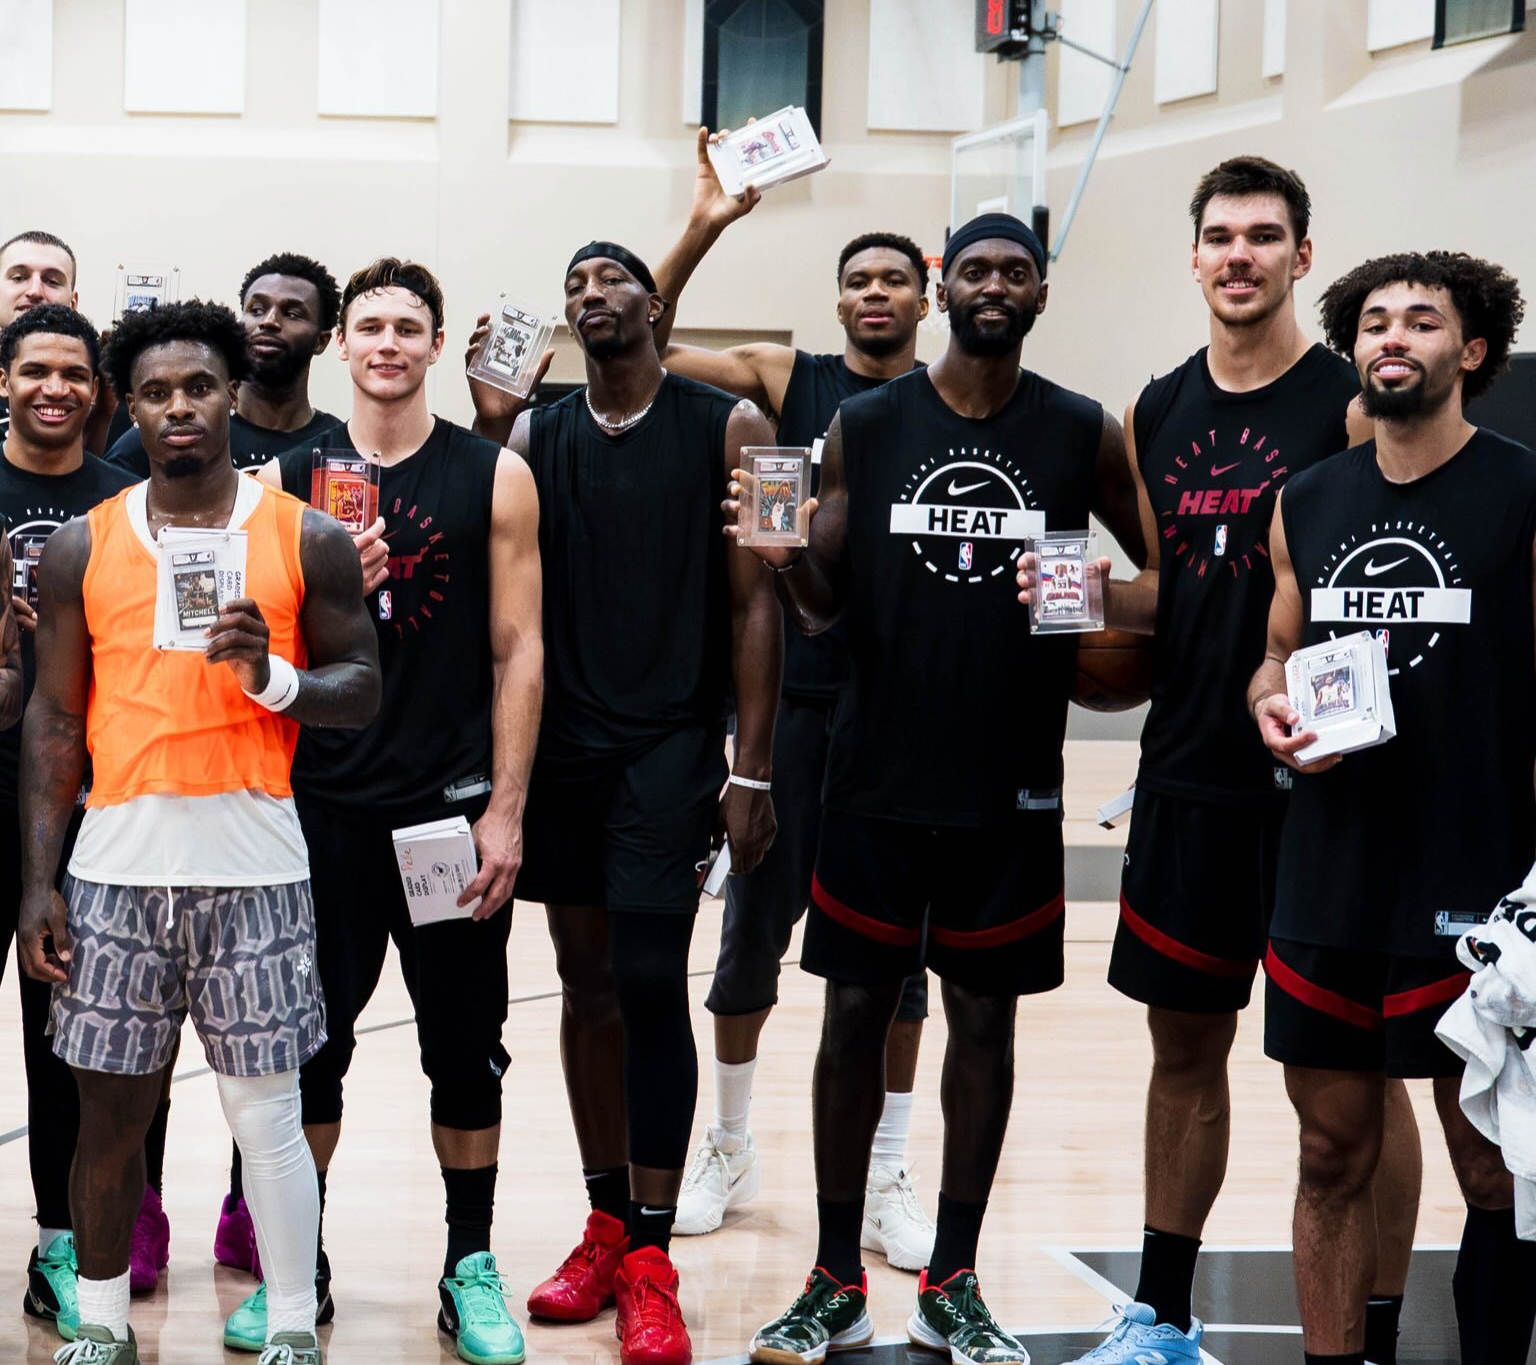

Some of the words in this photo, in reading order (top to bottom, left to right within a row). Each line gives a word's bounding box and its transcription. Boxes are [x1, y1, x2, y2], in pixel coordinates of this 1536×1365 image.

[1177, 480, 1270, 516] HEAT
[928, 507, 1008, 536] HEAT
[182, 606, 216, 618] MITCHELL
[1343, 590, 1425, 620] HEAT
